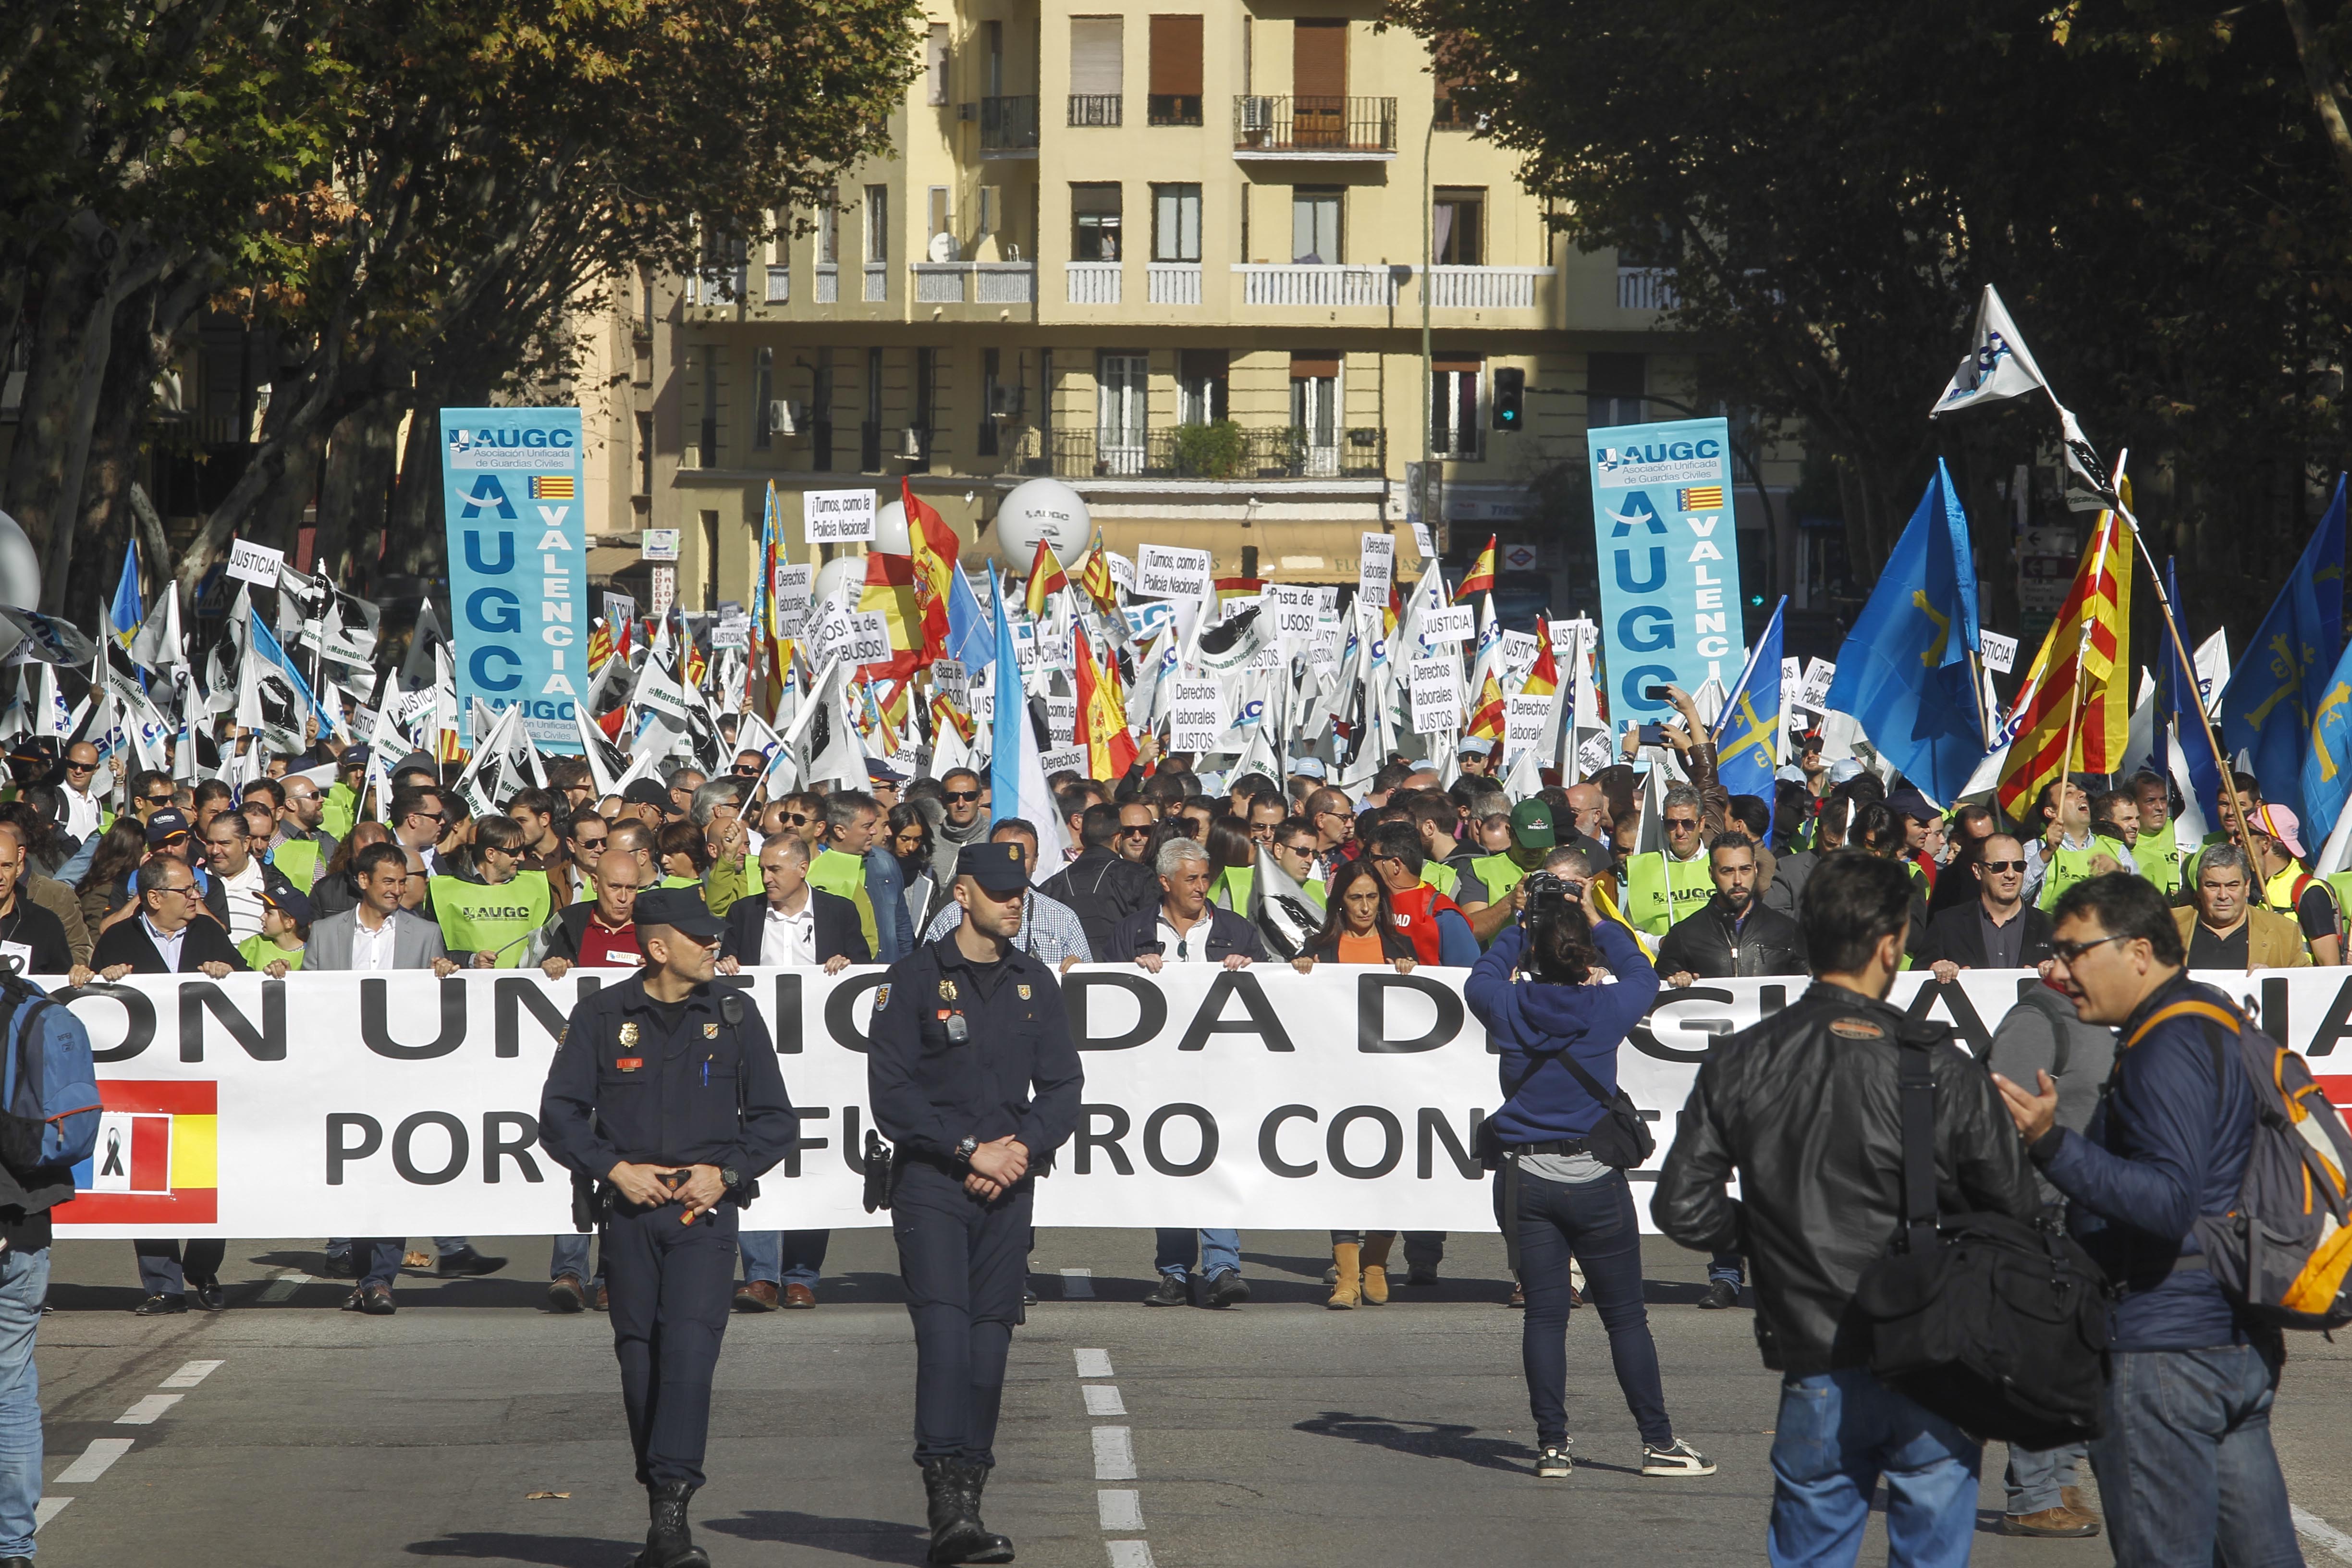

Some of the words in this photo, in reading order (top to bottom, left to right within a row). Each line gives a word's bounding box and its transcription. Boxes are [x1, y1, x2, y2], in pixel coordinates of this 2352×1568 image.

[474, 429, 573, 448] AUGC
[1622, 440, 1720, 465] AUGC
[490, 459, 531, 467] Guardias
[535, 459, 564, 467] Civiles
[1622, 464, 1671, 474] Asociación
[1675, 460, 1716, 470] Unificada
[1624, 476, 1636, 484] de
[1639, 473, 1679, 483] Guardias
[1682, 471, 1711, 479] Civiles
[843, 499, 862, 512] como
[864, 494, 870, 510] la
[813, 521, 836, 537] Policía
[839, 518, 870, 535] Nacional!
[1365, 537, 1390, 555] Derechos
[231, 549, 281, 576] JUSTICIA!
[1177, 556, 1196, 570] como
[1198, 555, 1205, 570] la
[1363, 561, 1388, 579] laborales
[460, 475, 523, 692] AUGC
[778, 570, 806, 587] Derechos
[1143, 574, 1166, 592] Policía
[1169, 577, 1203, 595] Nacional!
[537, 506, 576, 695] VALENCIA
[779, 594, 806, 612] laborales
[1303, 589, 1314, 605] de
[1362, 585, 1386, 603] JUSTOS.
[1611, 491, 1678, 711] AUGC
[1686, 515, 1729, 681] VALENCI
[864, 614, 878, 631] de
[1281, 614, 1314, 631] USOS!
[1425, 613, 1473, 634] JUSTICIA!
[1414, 664, 1450, 681] Derechos
[1176, 684, 1216, 700] Derechos
[1415, 688, 1452, 706] laborales
[1801, 687, 1825, 708] Policía
[1048, 705, 1066, 717] como
[1068, 702, 1075, 718] la
[1512, 698, 1550, 716] Derechos
[537, 721, 576, 730] Unificada
[1176, 708, 1216, 725] laborales
[1419, 710, 1455, 731] JUSTOS.
[544, 732, 571, 740] Civiles
[1050, 725, 1074, 742] acional!
[1041, 751, 1081, 770] Derechos
[477, 906, 529, 918] AUGC
[50, 980, 287, 1063] ON
[327, 1111, 544, 1185] POR
[1258, 1104, 1485, 1180] CON
